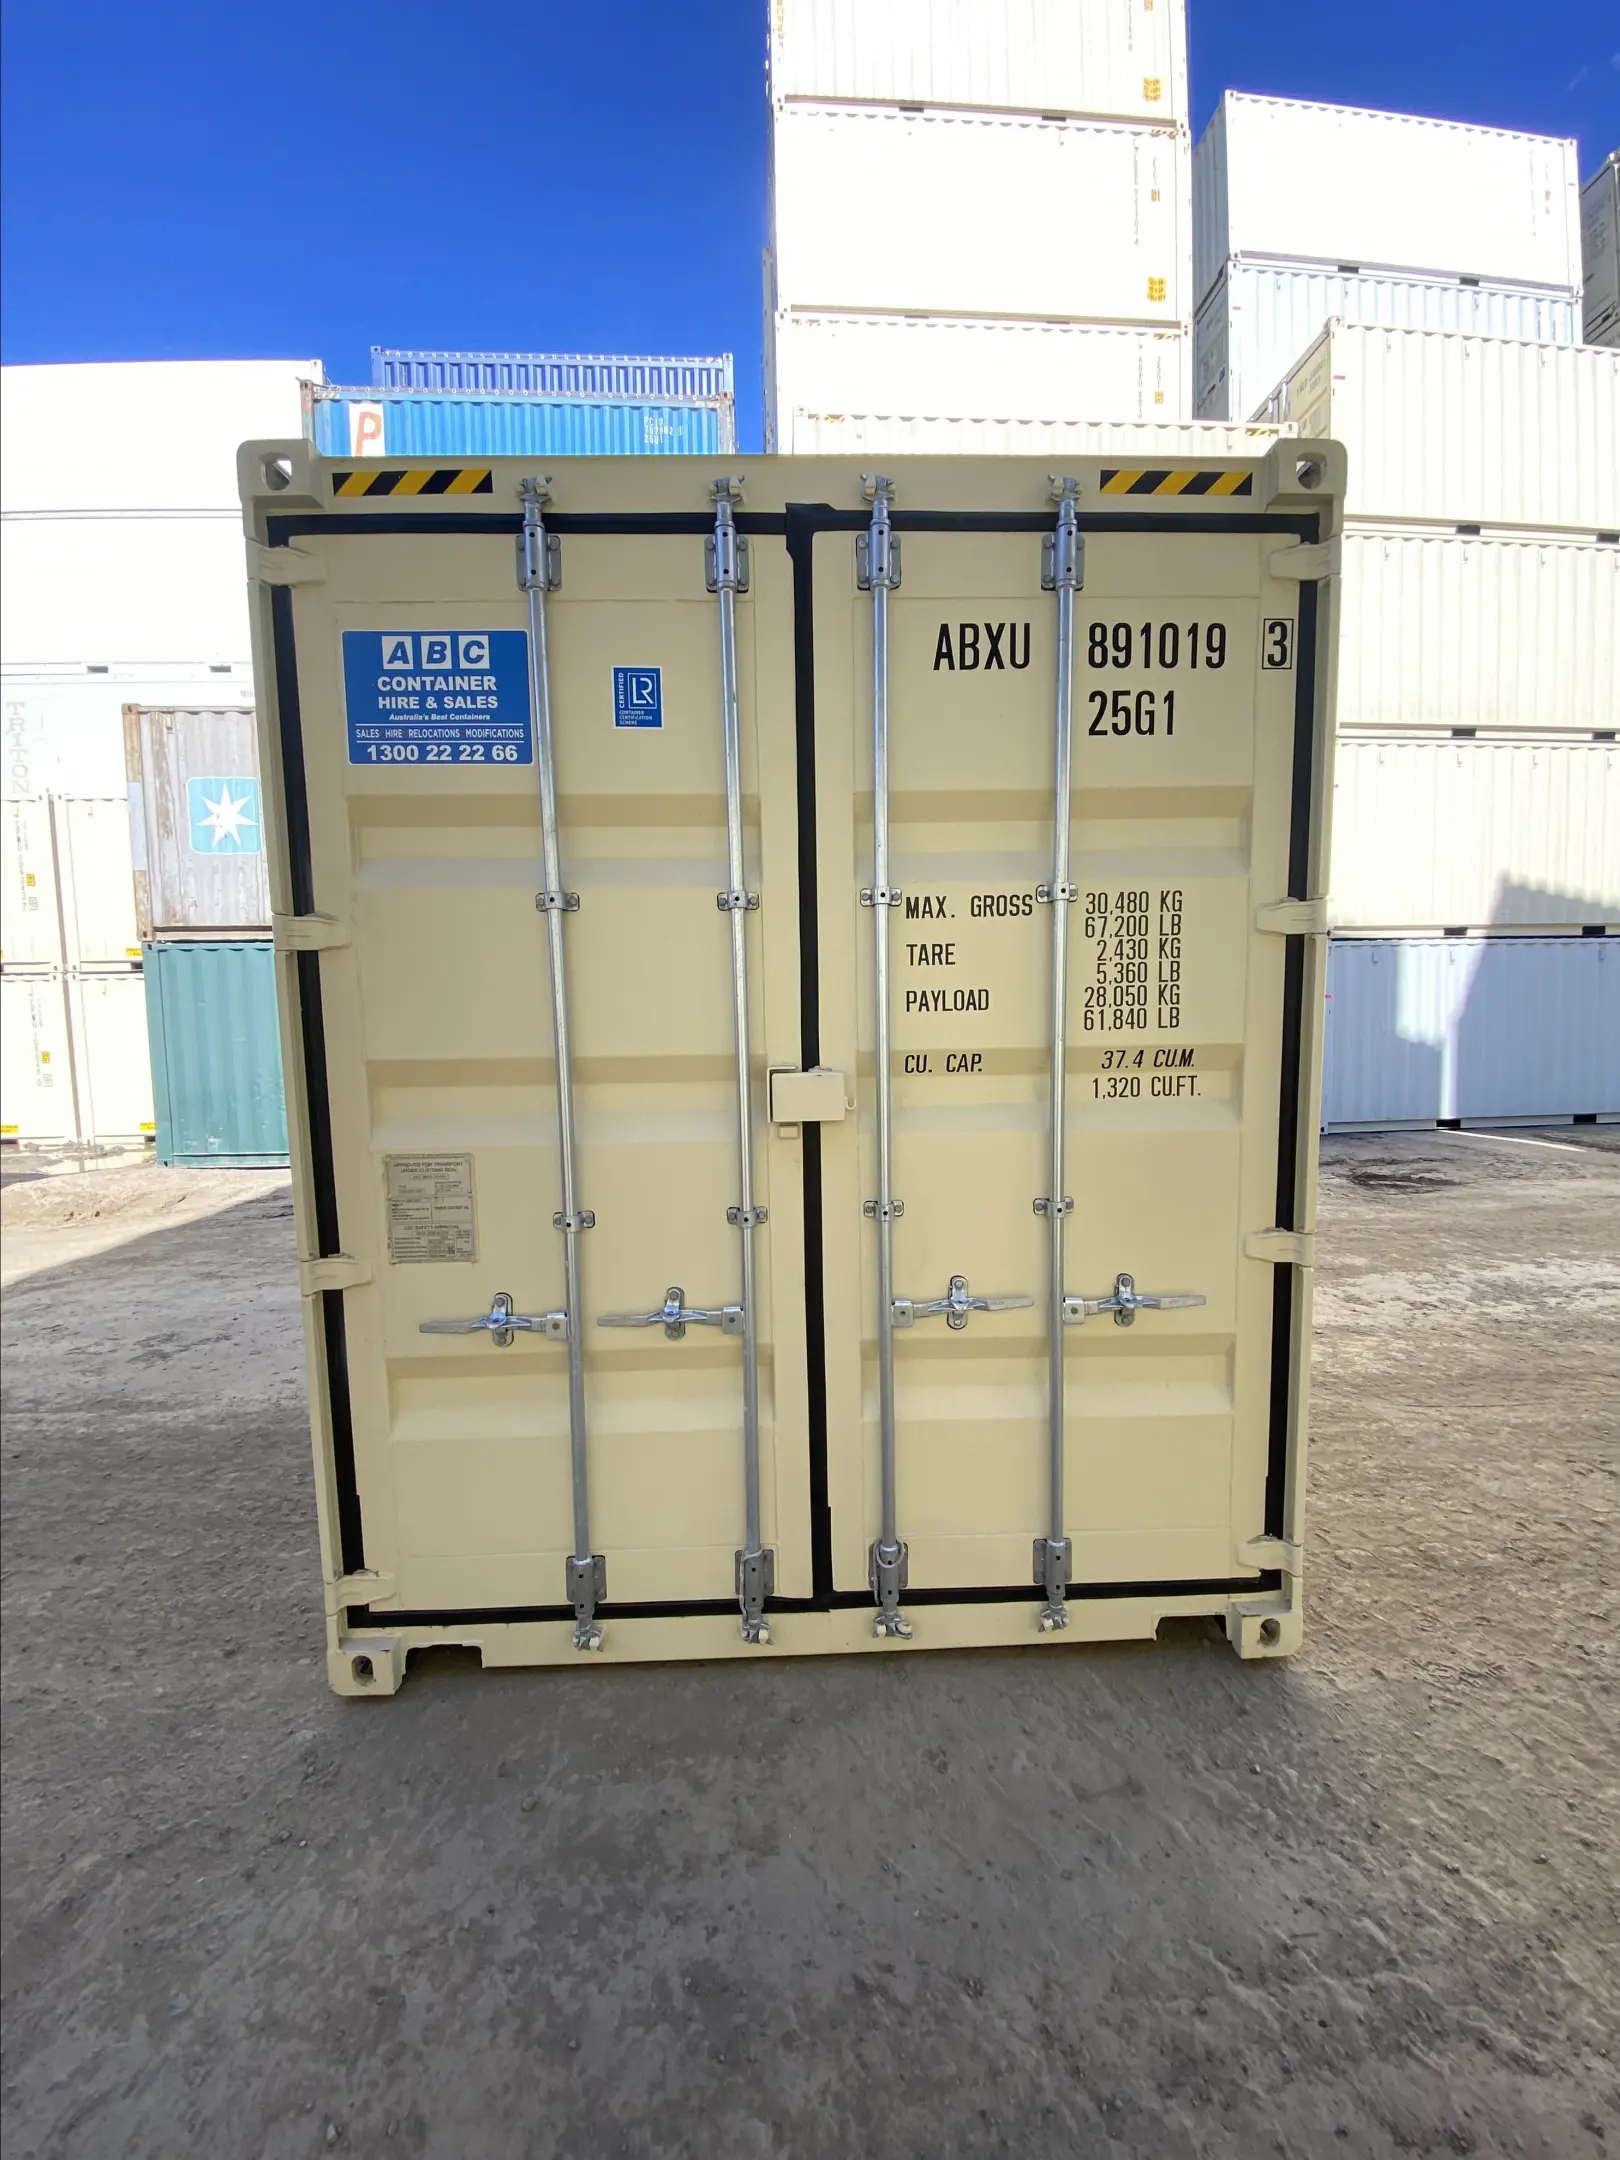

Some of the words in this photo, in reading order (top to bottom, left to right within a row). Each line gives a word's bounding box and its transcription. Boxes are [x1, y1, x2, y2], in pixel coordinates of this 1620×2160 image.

[386, 637, 487, 667] ABC
[933, 622, 1031, 671] ABXU
[1088, 622, 1227, 669] 891019
[1267, 621, 1289, 668] 3
[377, 675, 498, 692] CONTAINER
[378, 696, 420, 709] HIRE
[425, 696, 438, 709] &
[443, 695, 499, 709] SALES
[1088, 689, 1175, 736] 25G1
[388, 713, 430, 721] Australia's
[430, 713, 448, 721] Best
[449, 713, 491, 721] Containers
[355, 728, 380, 738] SALES
[385, 728, 403, 738] HIRE
[408, 728, 461, 738] RELOCATIONS
[465, 728, 525, 738] MODIFICATIONS
[366, 744, 419, 761] 1300
[425, 744, 453, 761] 22
[458, 744, 485, 761] 22
[491, 744, 518, 762] 66
[905, 895, 956, 920] MAX.
[970, 893, 1034, 918] GROSS
[1085, 890, 1150, 916] 30,480
[1160, 889, 1183, 913] KG
[1085, 914, 1149, 939] 67,200
[1159, 913, 1182, 937] LB
[905, 942, 956, 967] TARE
[1096, 938, 1148, 962] 2,430
[1158, 937, 1181, 960] KG
[1096, 961, 1148, 986] 5,360
[1158, 960, 1181, 983] LB
[906, 988, 989, 1013] PAYLOAD
[1084, 984, 1148, 1009] 28,050
[1158, 983, 1180, 1006] KG
[1083, 1007, 1147, 1032] 61,840
[1157, 1006, 1180, 1029] LB
[904, 1054, 933, 1074] CU.
[946, 1053, 983, 1073] CAP.
[1101, 1049, 1145, 1070] 37.4
[1092, 1076, 1141, 1100] 1,320
